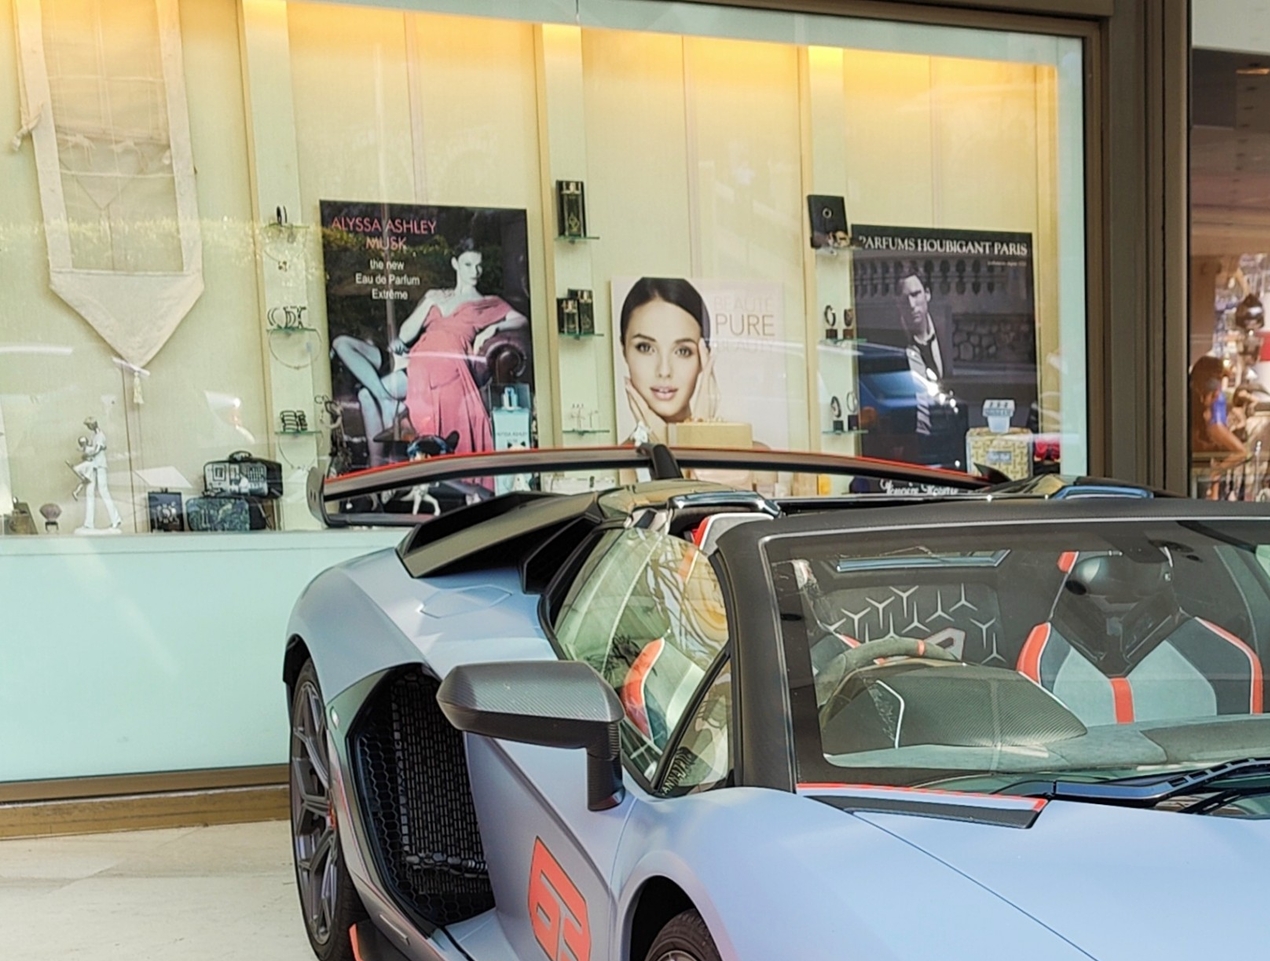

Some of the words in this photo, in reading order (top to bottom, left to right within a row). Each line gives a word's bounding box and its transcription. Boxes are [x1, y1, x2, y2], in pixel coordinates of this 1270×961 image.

[331, 217, 382, 232] ALYSSA
[385, 219, 437, 234] ASHLEY
[365, 236, 407, 251] MUSK
[917, 238, 991, 254] HOUBIGANT
[993, 241, 1028, 256] PARIS
[369, 259, 384, 270] the
[386, 260, 405, 271] new
[355, 273, 374, 284] Eau
[375, 274, 387, 285] de
[388, 273, 420, 286] Parfum
[371, 288, 408, 301] Extrême
[715, 313, 776, 337] PURE
